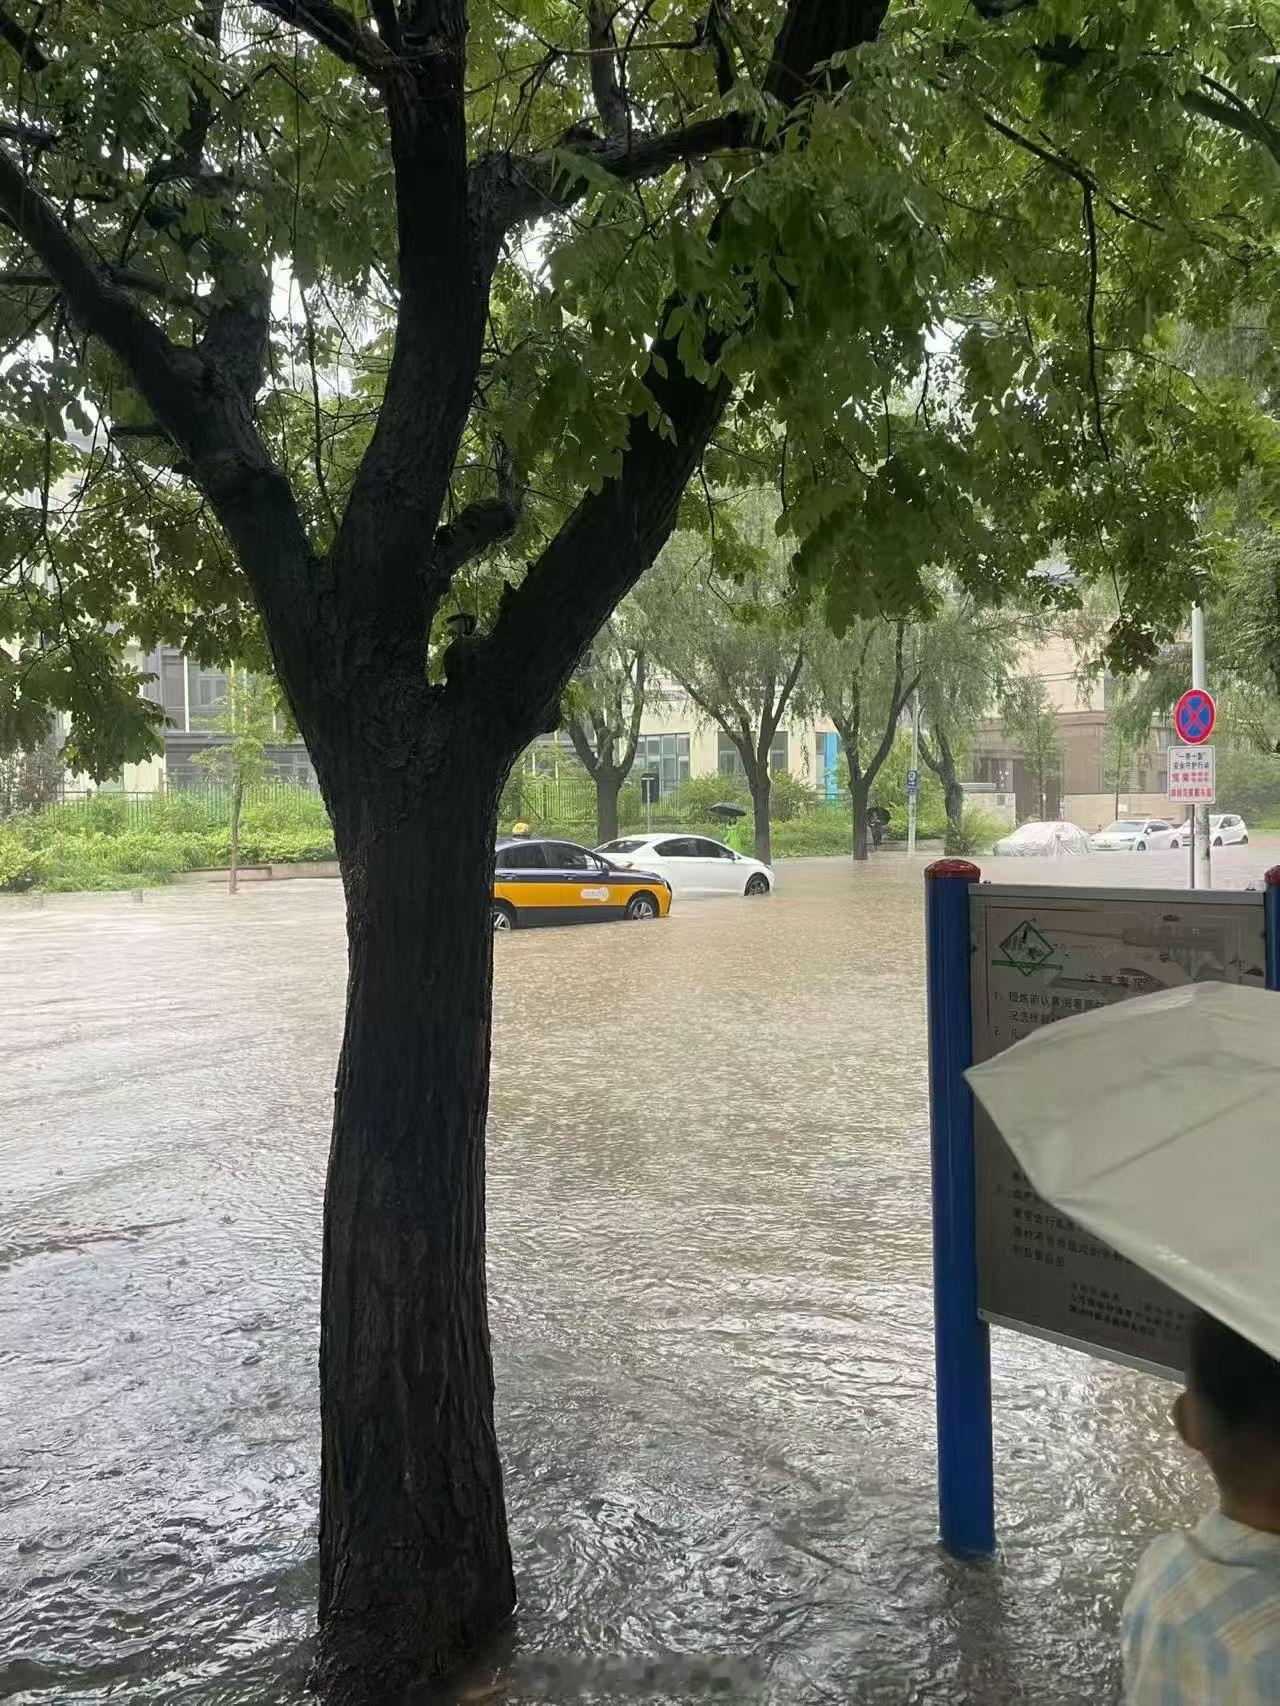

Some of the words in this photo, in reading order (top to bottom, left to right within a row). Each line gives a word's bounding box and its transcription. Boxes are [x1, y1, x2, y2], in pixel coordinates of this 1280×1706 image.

[1173, 761, 1209, 769] 安全守护行动
